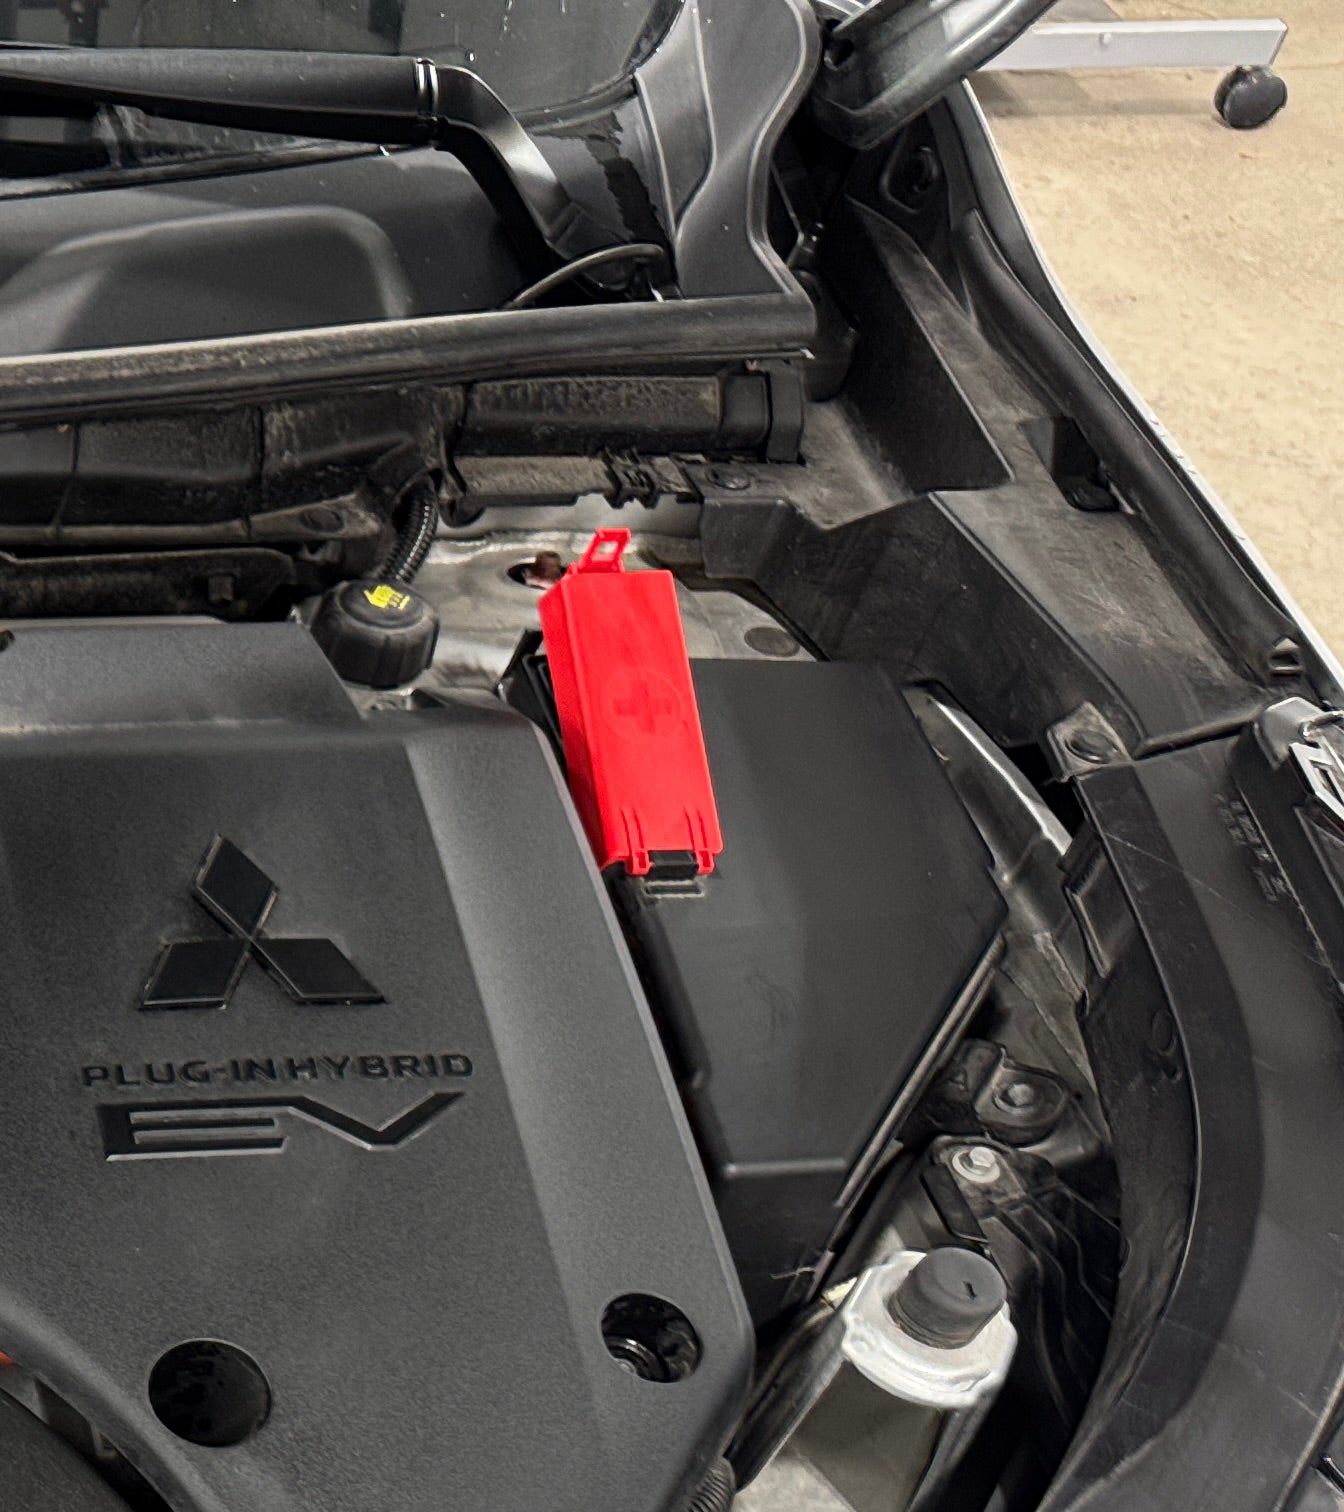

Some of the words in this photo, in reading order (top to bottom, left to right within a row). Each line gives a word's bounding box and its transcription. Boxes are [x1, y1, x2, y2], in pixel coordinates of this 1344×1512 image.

[81, 1058, 276, 1087] PLUG-IN
[290, 1053, 474, 1083] HYBRID
[96, 1092, 466, 1161] EV
